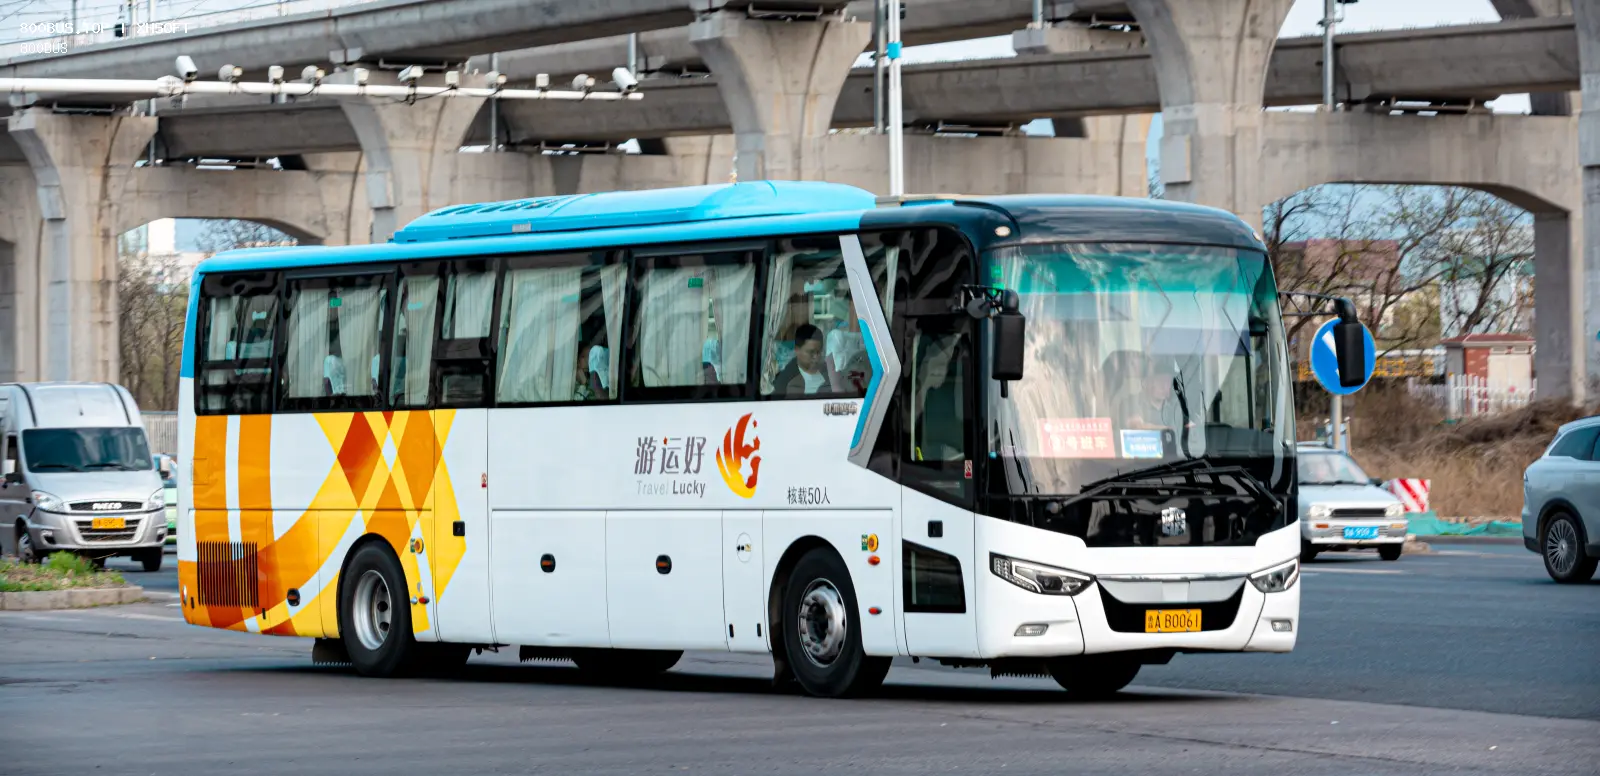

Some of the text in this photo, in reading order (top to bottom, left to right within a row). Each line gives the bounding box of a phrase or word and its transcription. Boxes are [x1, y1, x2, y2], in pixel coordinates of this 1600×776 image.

[634, 436, 707, 475] 游运好
[636, 479, 706, 498] Travel Lucky
[787, 486, 831, 505] 核载50人
